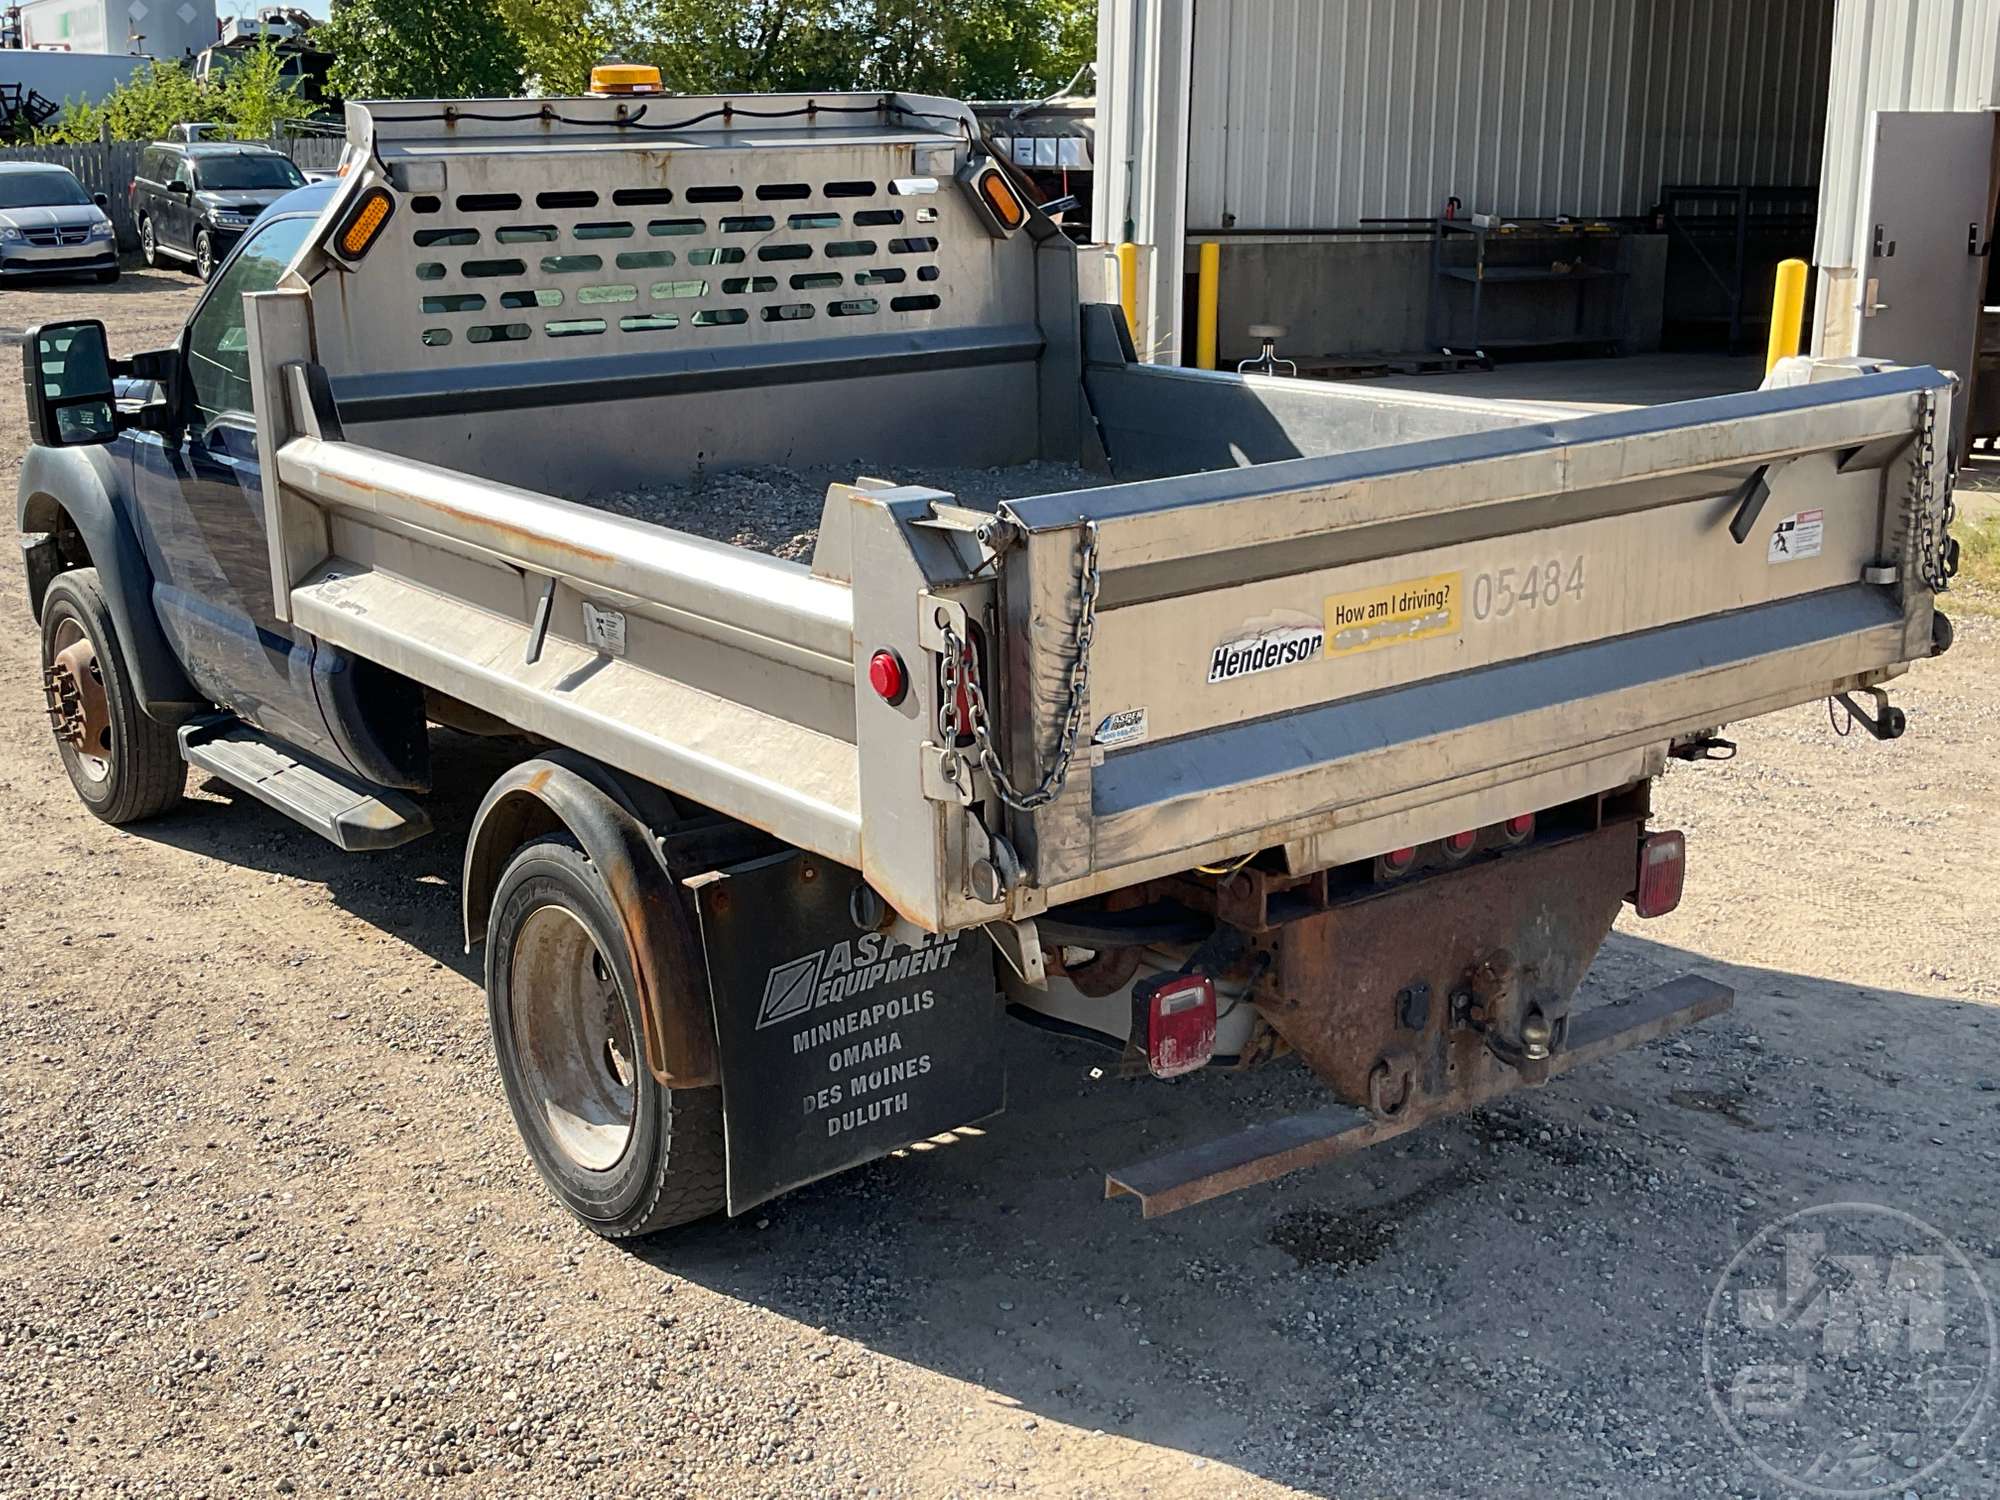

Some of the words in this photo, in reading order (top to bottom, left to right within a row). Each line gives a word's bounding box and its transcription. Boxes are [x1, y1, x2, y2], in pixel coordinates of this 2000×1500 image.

[1336, 605, 1365, 625] How
[1368, 602, 1387, 619] am
[1392, 595, 1396, 614] I
[1399, 585, 1450, 612] driving?
[1473, 555, 1584, 620] 05484
[1210, 634, 1322, 679] Henderson
[815, 942, 958, 1008] EQUIPMENT
[793, 990, 935, 1054] MINNEAPOLIS
[829, 1032, 901, 1072] OMAHA
[803, 1084, 842, 1115] DES
[851, 1055, 931, 1097] MOINES
[828, 1092, 908, 1136] DULUTH
